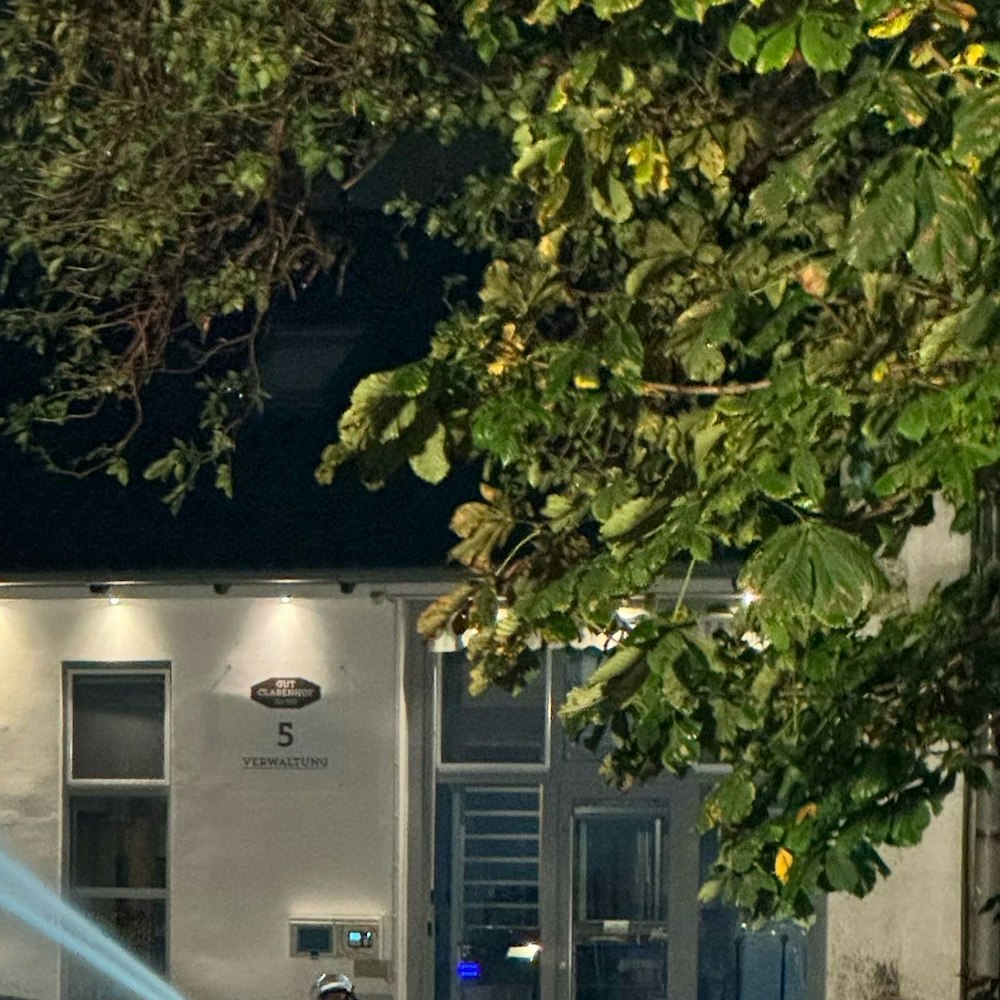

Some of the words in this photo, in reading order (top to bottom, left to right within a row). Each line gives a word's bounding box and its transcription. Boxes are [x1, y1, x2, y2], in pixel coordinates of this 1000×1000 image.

[275, 680, 296, 688] GUT
[277, 722, 294, 747] 5
[242, 757, 328, 767] VERWALTUNG
